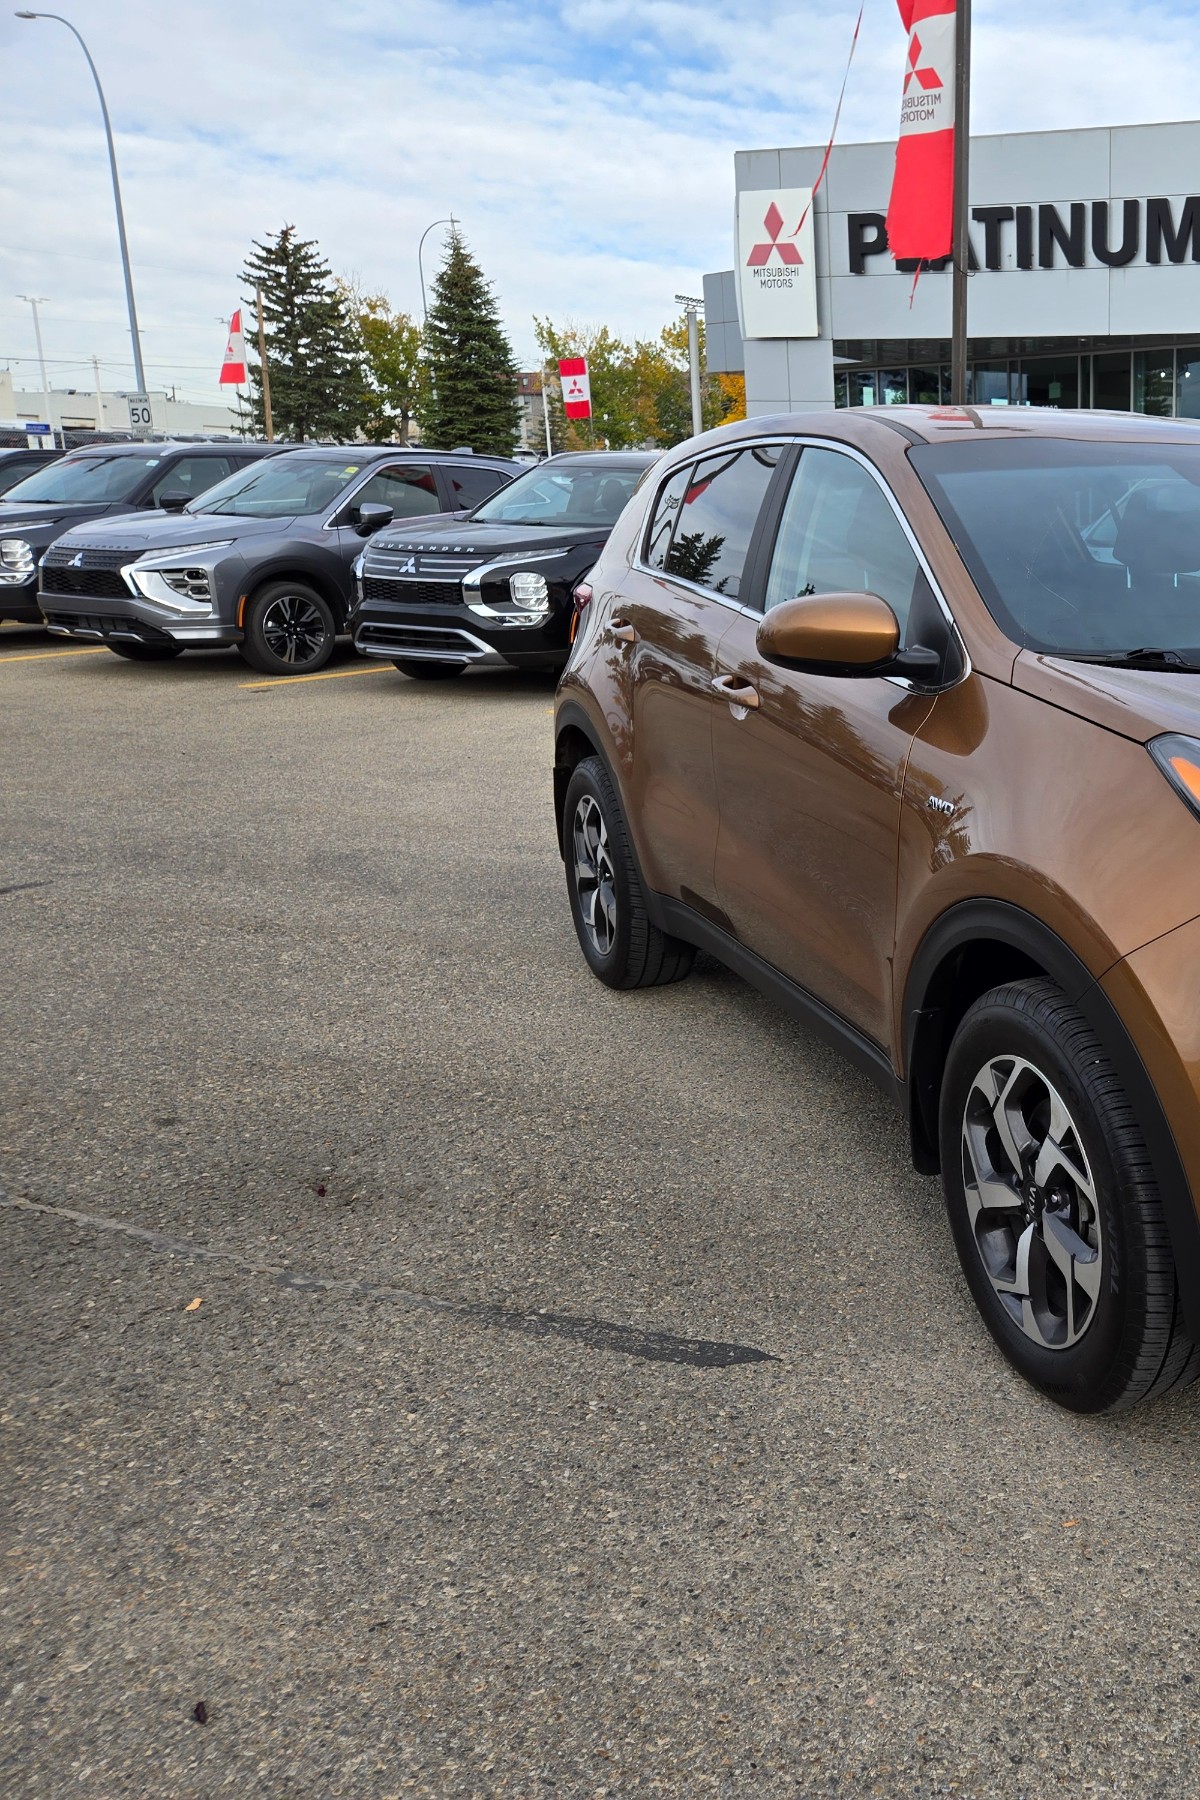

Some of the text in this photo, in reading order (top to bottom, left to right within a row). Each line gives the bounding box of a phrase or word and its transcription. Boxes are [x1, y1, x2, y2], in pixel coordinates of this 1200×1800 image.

[753, 266, 799, 278] MITSUBISHI
[760, 278, 793, 289] MOTORS
[131, 407, 151, 424] 50
[379, 543, 475, 553] OUTLANDER
[926, 795, 955, 817] AWD
